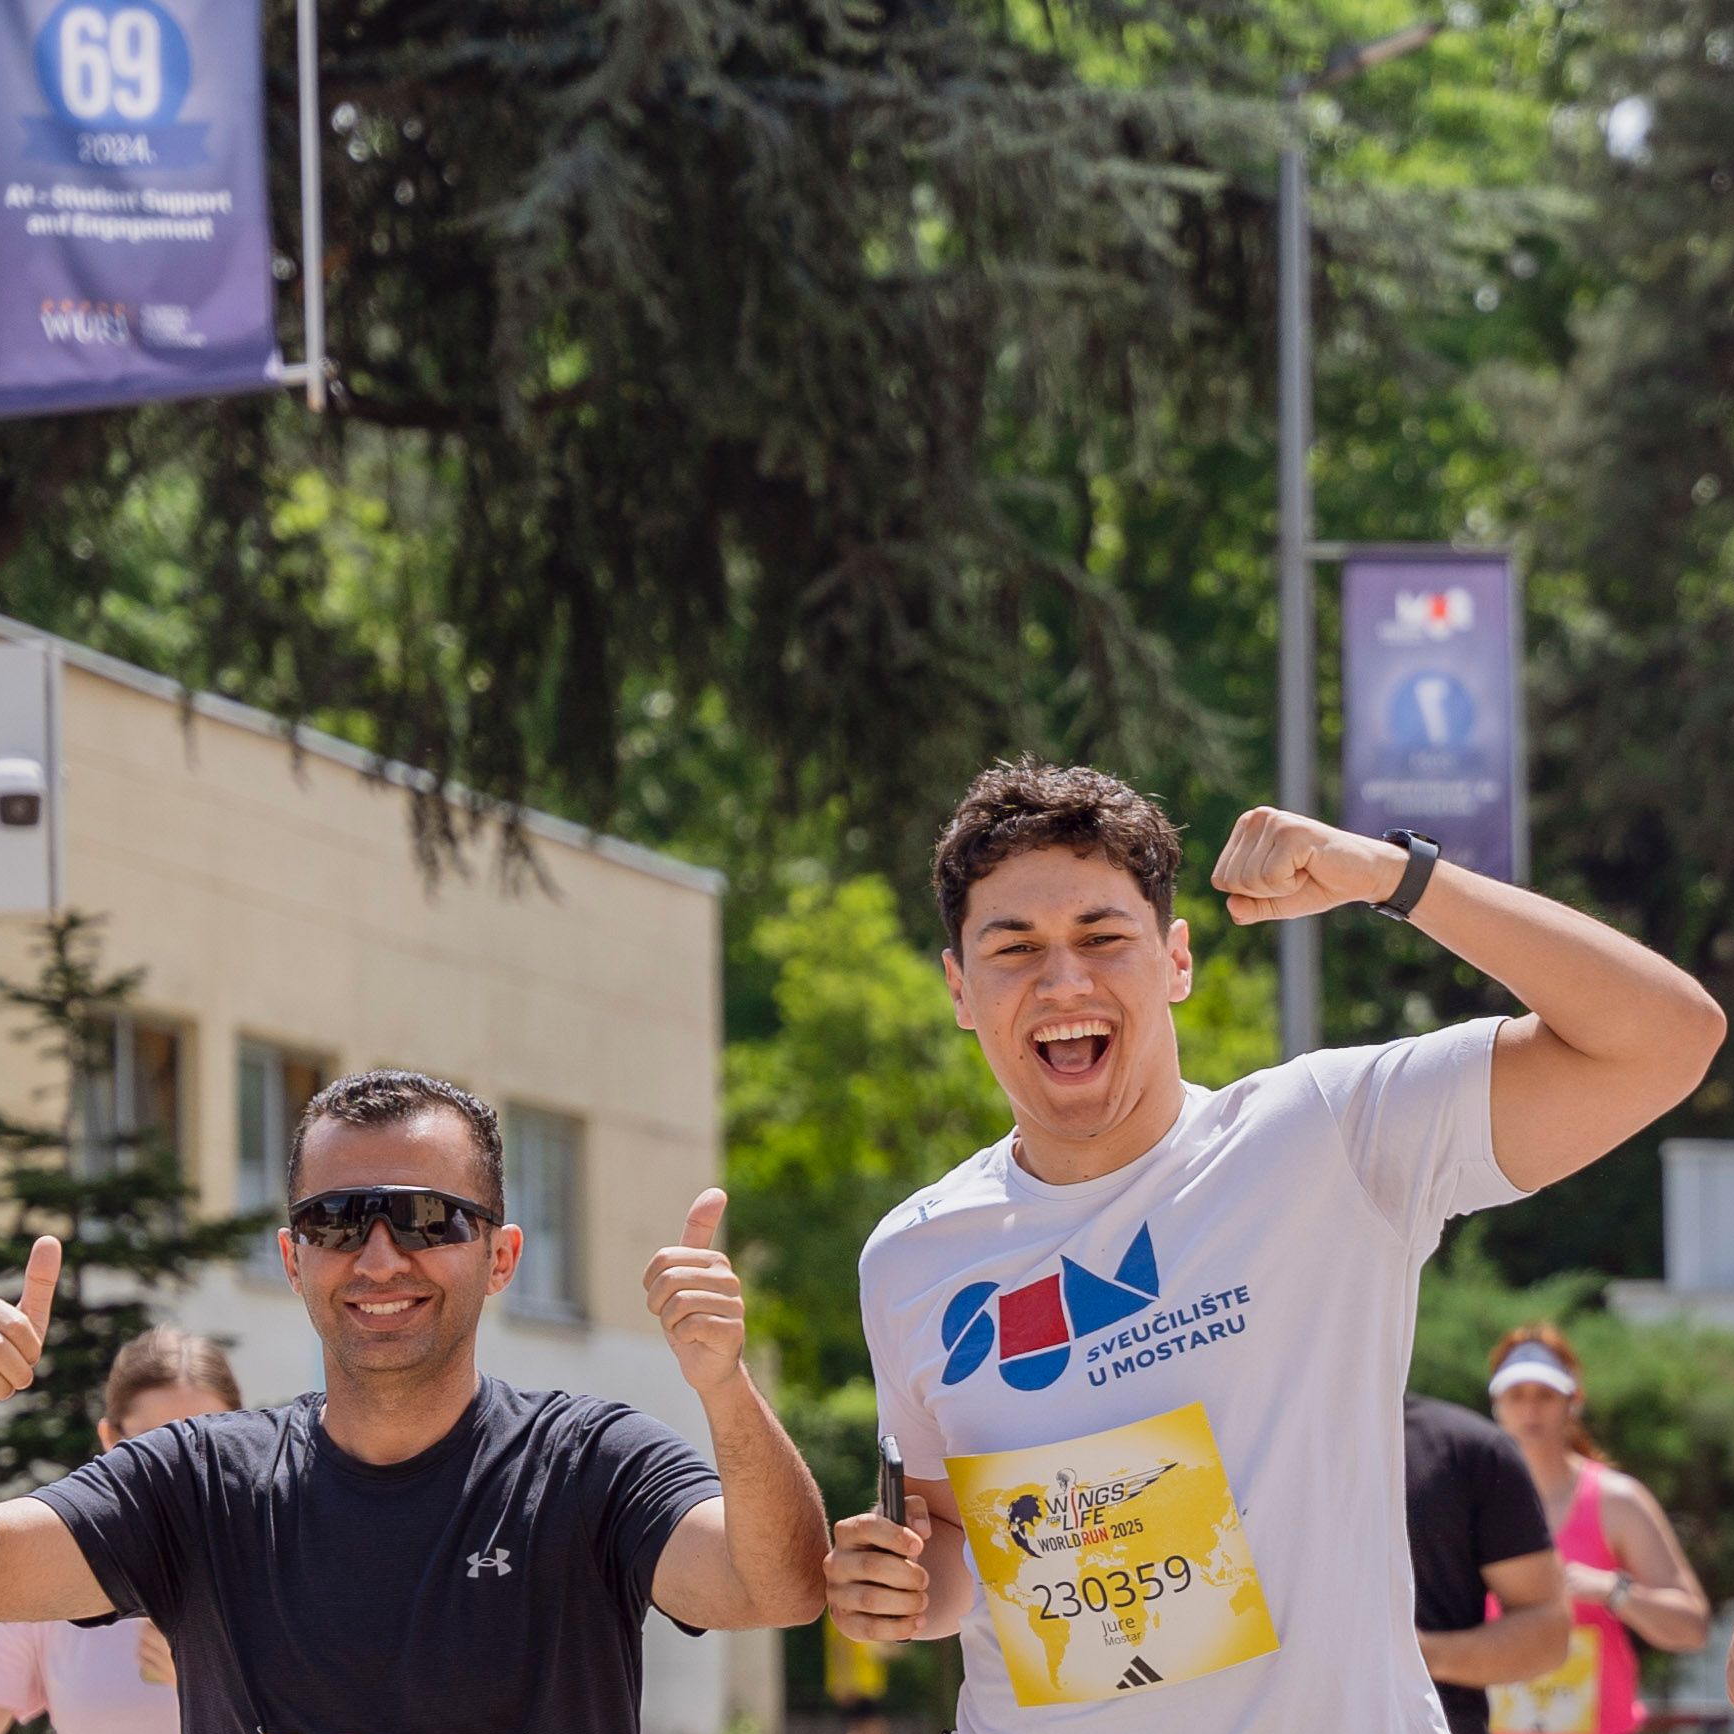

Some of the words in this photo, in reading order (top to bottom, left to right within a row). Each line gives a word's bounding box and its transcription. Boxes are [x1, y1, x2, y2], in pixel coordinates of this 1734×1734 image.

[60, 6, 162, 120] 69
[72, 213, 215, 244] Engagement
[1086, 1284, 1251, 1364] SVEUČILIŠTE
[1087, 1367, 1108, 1387] U
[1114, 1314, 1246, 1379] MOSTARU
[1044, 1483, 1125, 1516] WINGS
[1062, 1506, 1105, 1532] LIFE
[1112, 1518, 1144, 1541] 2025
[1031, 1555, 1192, 1620] 230359
[1102, 1615, 1136, 1637] Jure
[1104, 1630, 1143, 1648] Mostar
